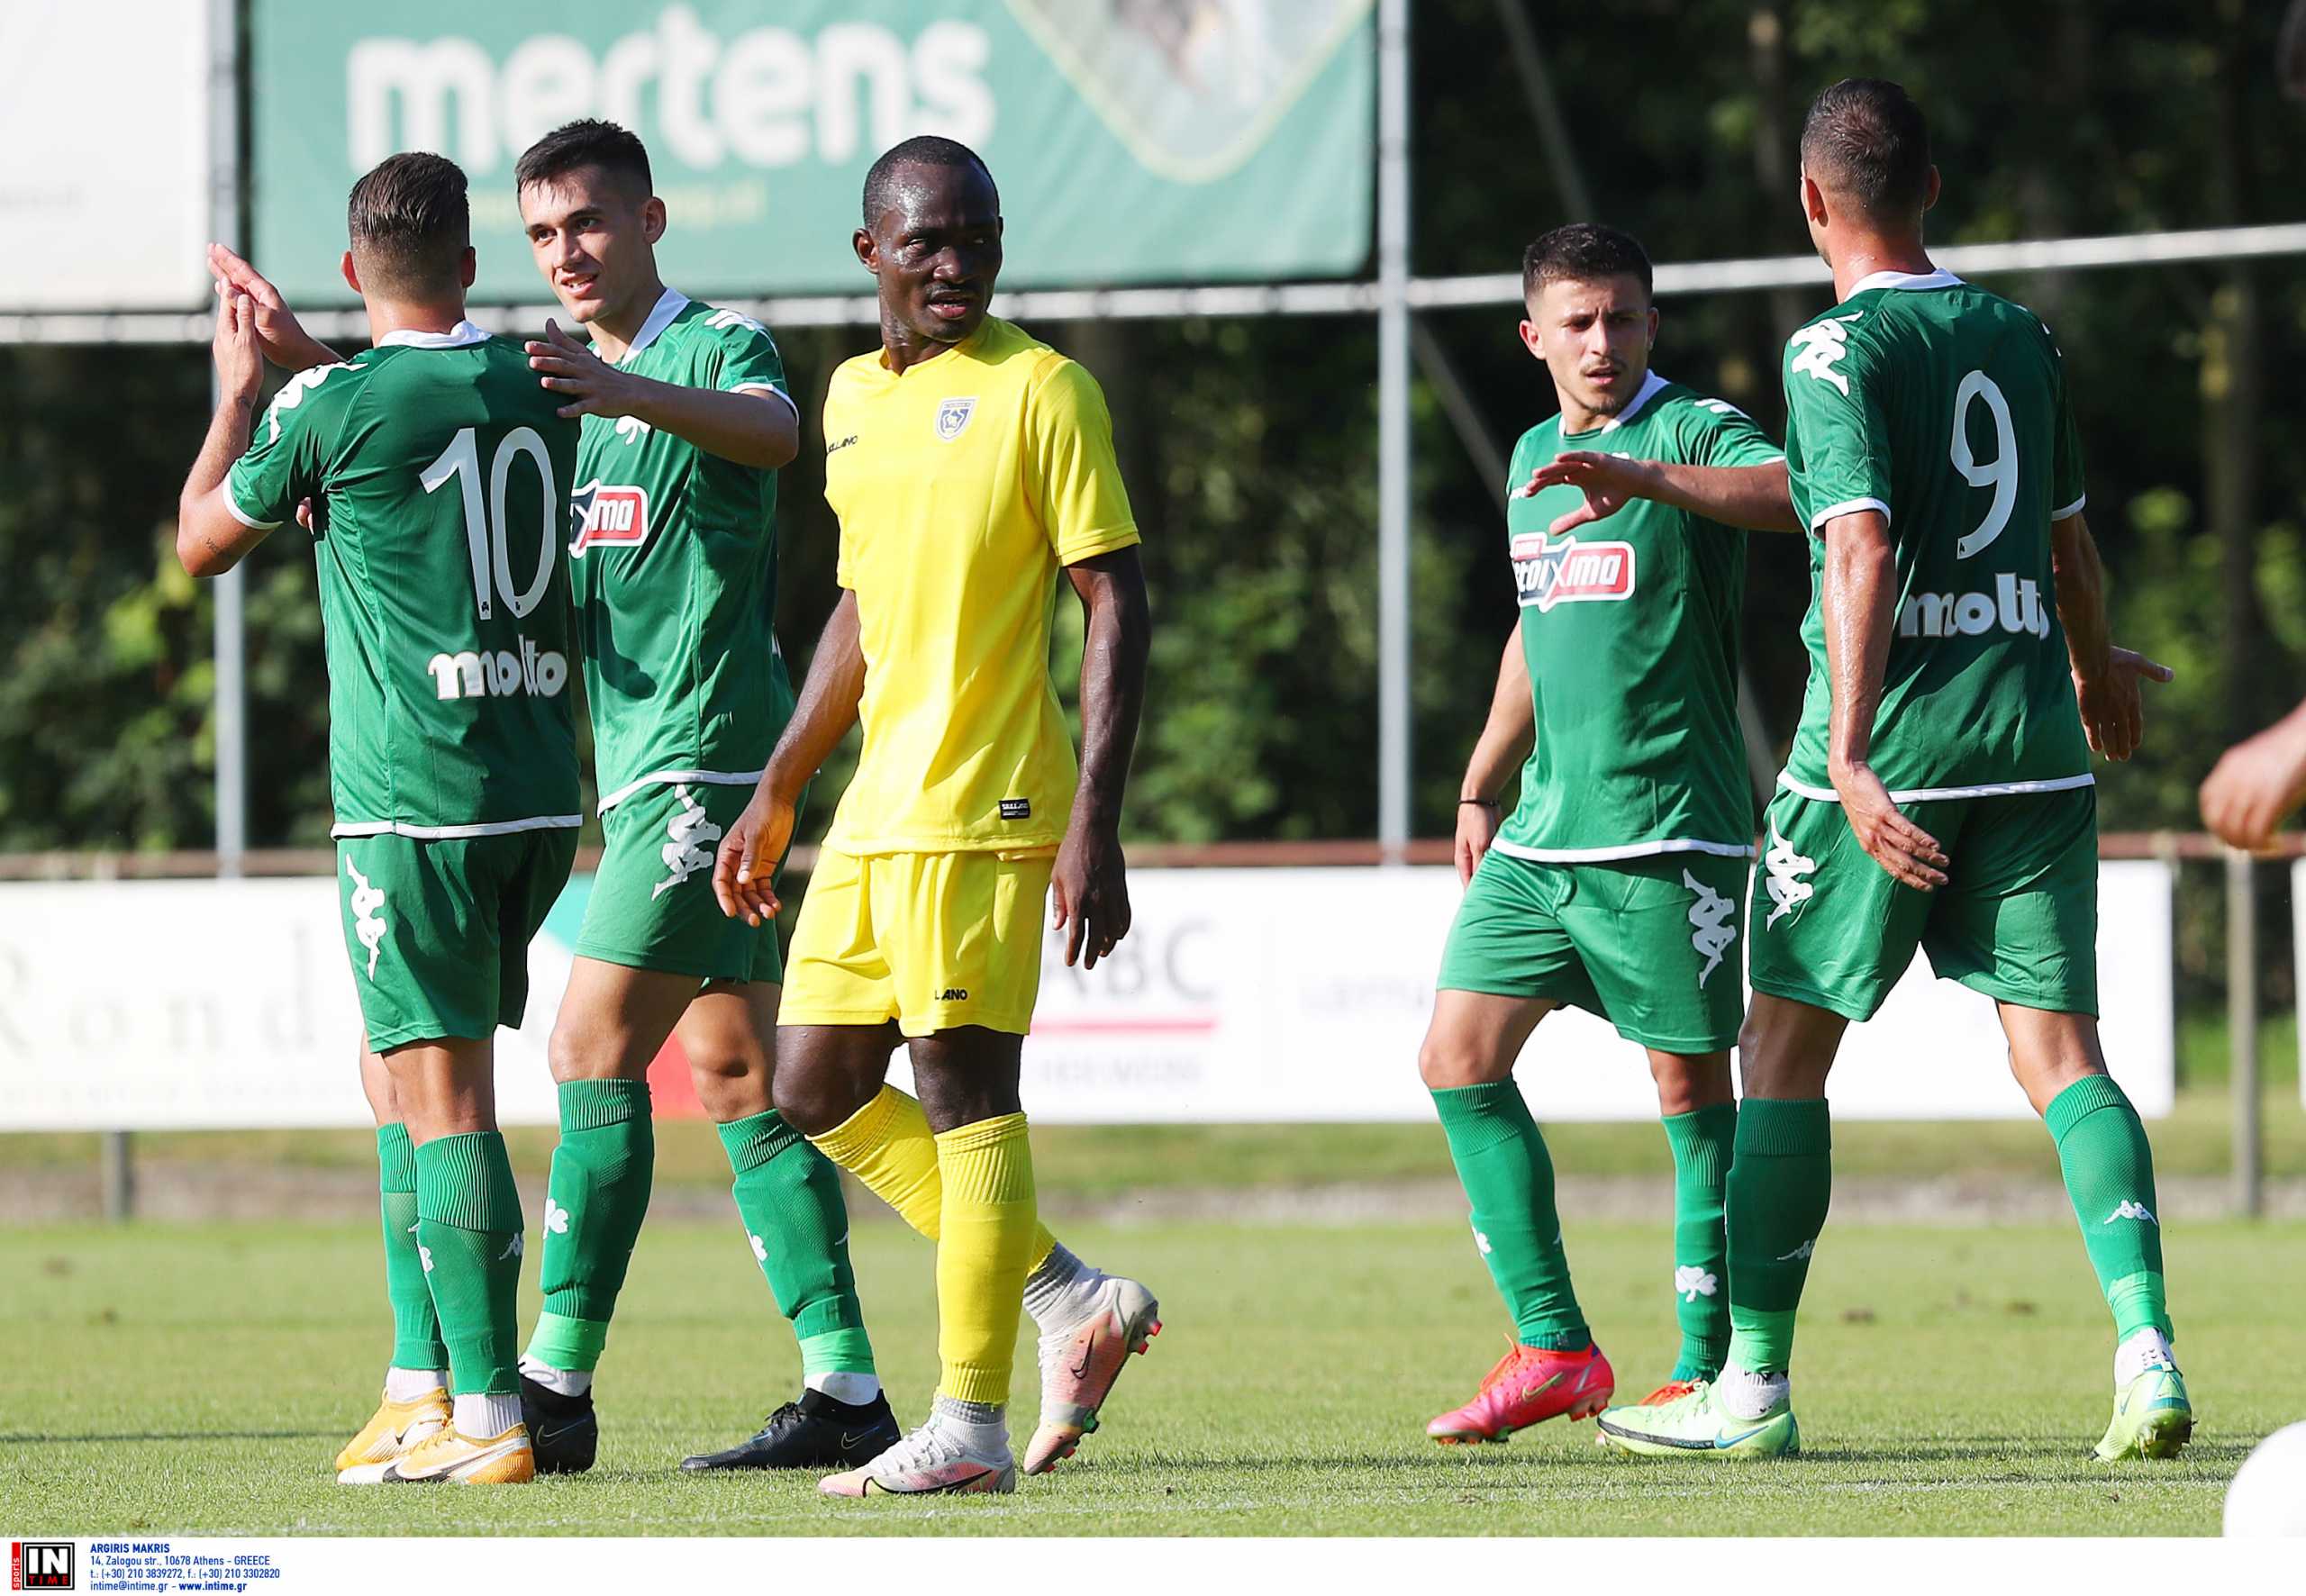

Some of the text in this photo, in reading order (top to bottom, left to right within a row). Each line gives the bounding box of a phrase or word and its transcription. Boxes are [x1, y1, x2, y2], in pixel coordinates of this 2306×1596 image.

[347, 3, 995, 173] mertens
[419, 426, 557, 620] 10
[1950, 370, 2018, 559] 9
[428, 634, 567, 700] molto
